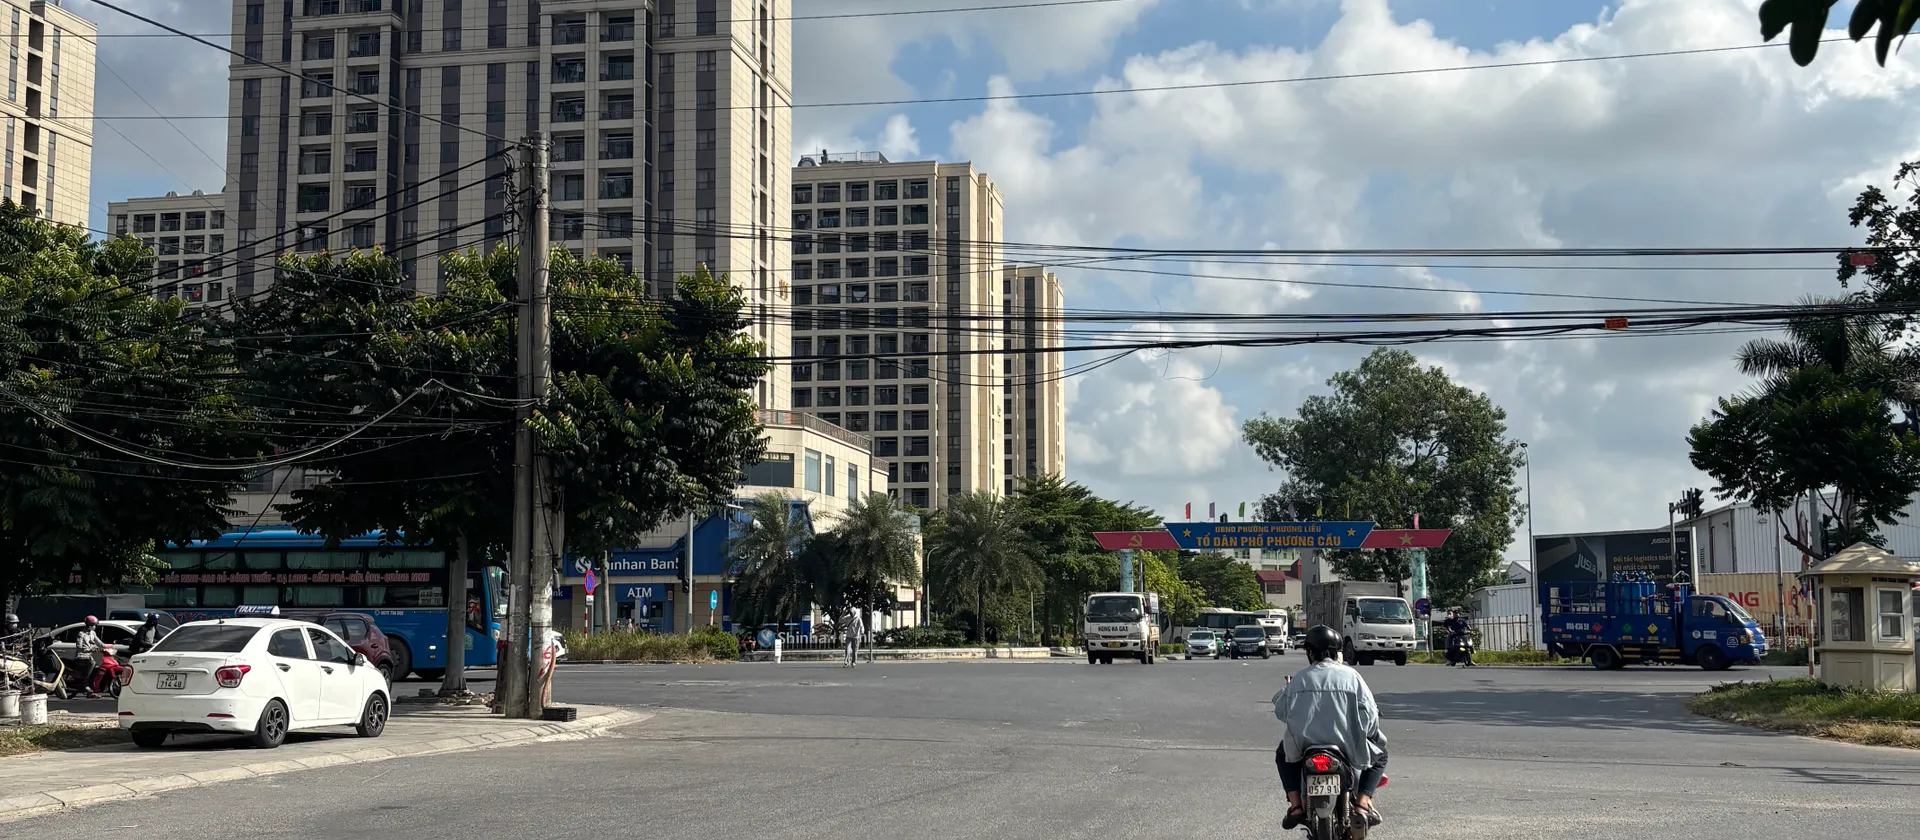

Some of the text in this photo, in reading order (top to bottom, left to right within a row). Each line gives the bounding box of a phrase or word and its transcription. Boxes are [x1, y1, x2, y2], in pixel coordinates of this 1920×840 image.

[1213, 534, 1238, 547] DÂN
[1240, 533, 1263, 547] PHỐ
[1266, 535, 1314, 547] PHƯƠNG
[1633, 554, 1658, 563] logistics
[627, 587, 652, 598] ATM
[238, 605, 257, 613] TAXI
[166, 674, 178, 682] 20A
